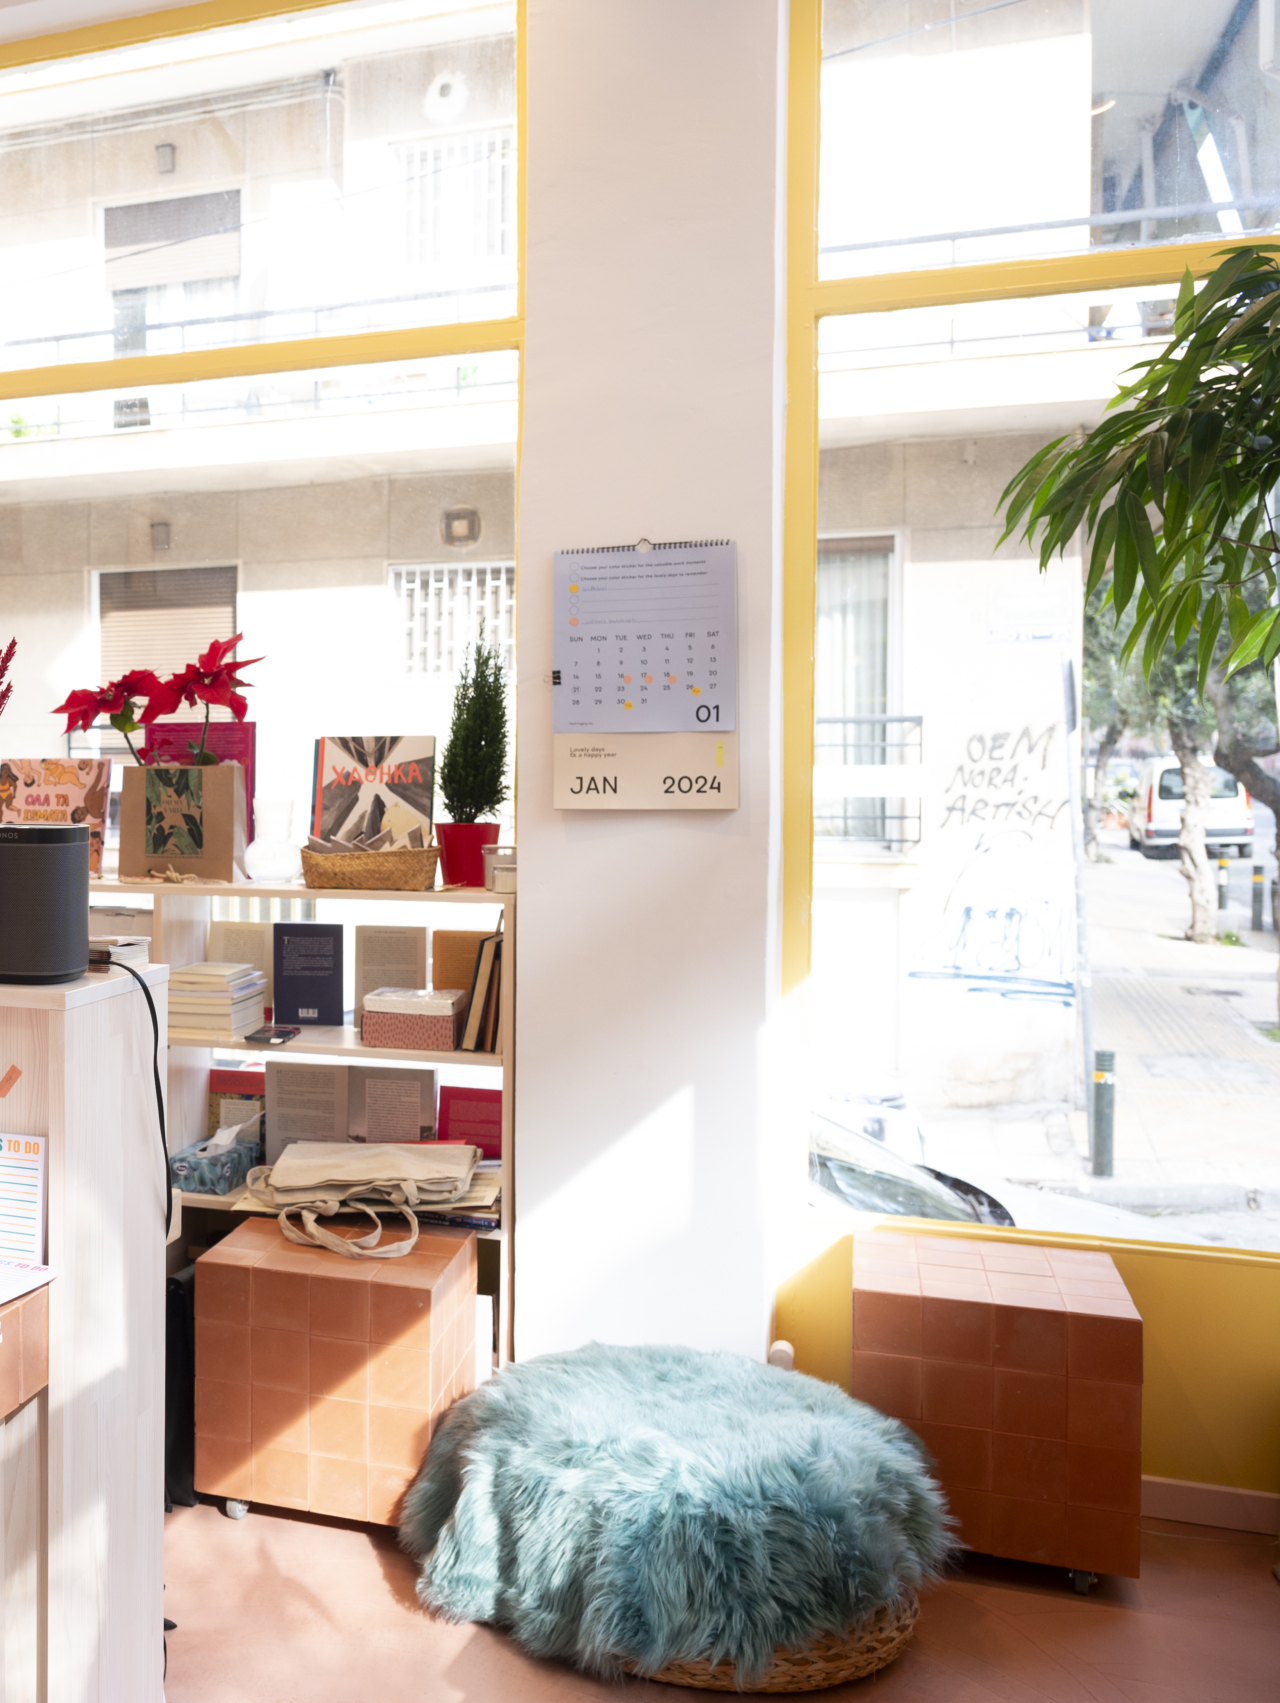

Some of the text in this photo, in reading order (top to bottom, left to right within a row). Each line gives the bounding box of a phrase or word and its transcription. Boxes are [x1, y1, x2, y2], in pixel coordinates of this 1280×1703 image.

[695, 704, 719, 723] 01
[967, 723, 1057, 771] OEM
[331, 762, 422, 790] ΧΑΘΗΚΑ
[570, 776, 721, 794] JAN 2024
[25, 794, 69, 807] ΟΛΑ ΤΑ
[23, 810, 67, 822] ΣΩΜΑΤΑ
[7, 1139, 20, 1153] TO
[24, 1141, 40, 1155] DO
